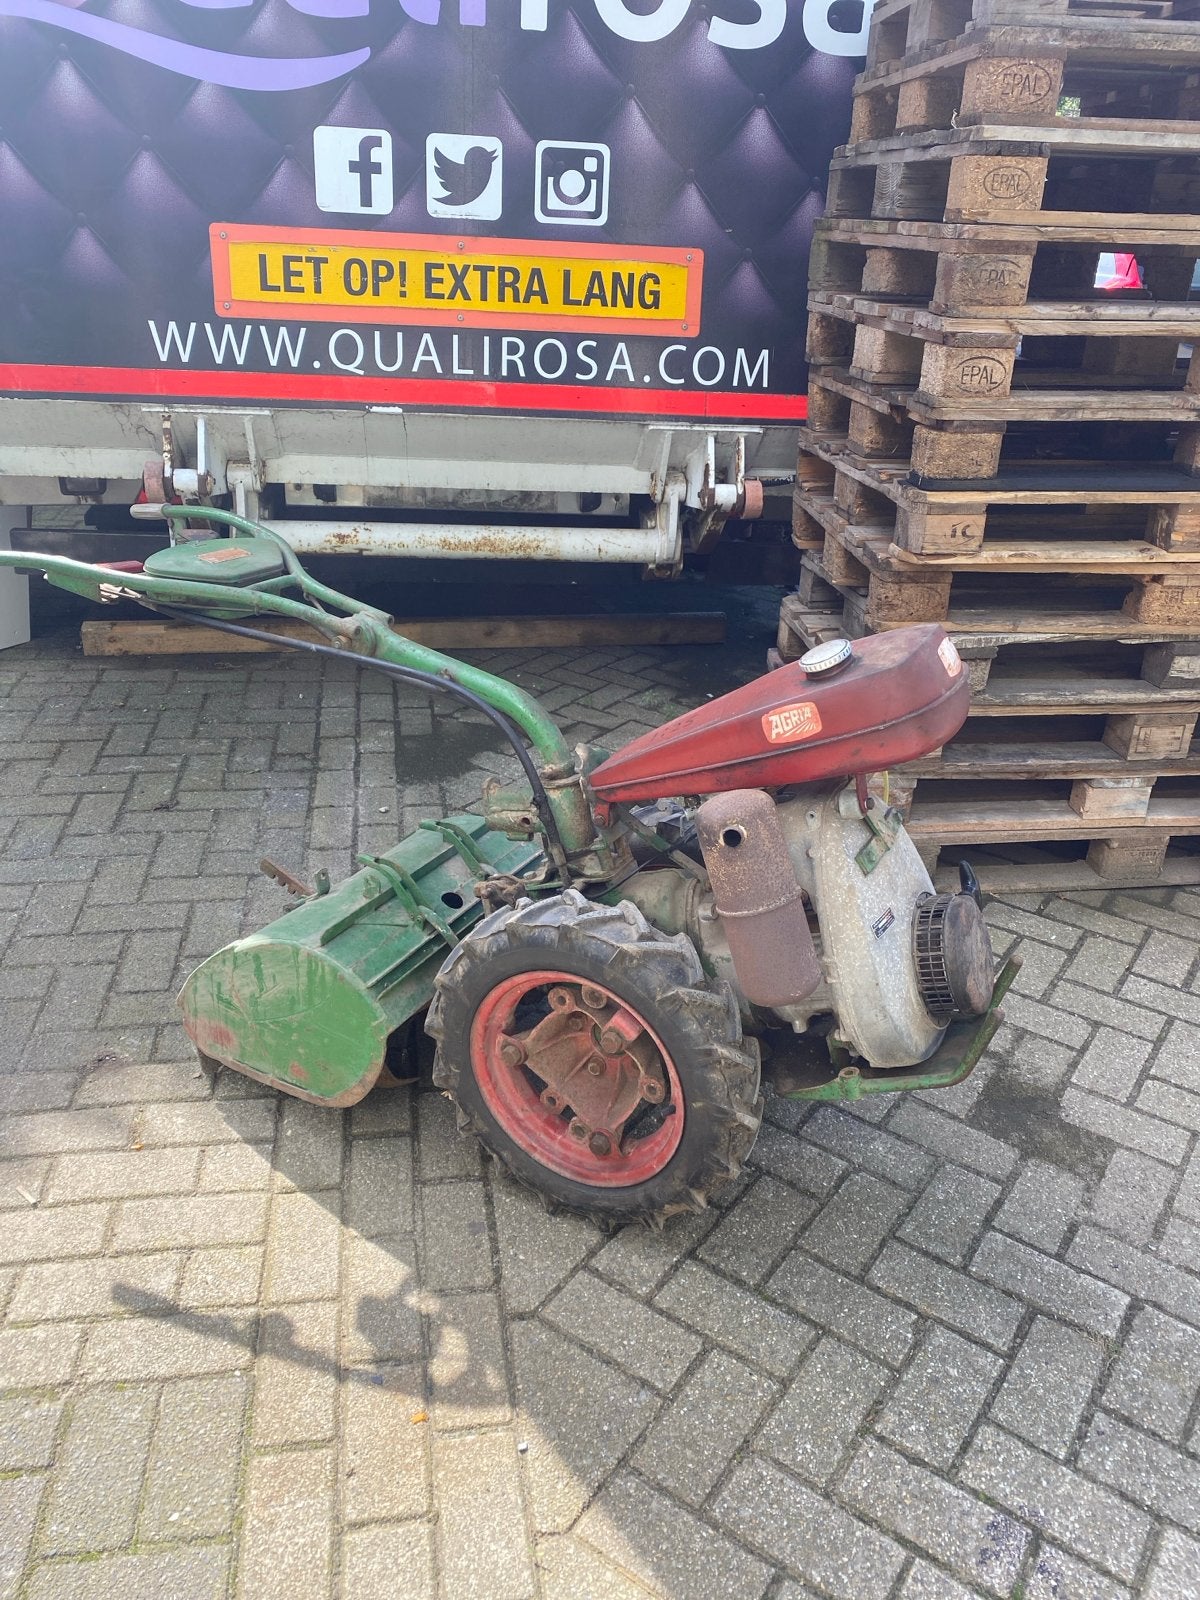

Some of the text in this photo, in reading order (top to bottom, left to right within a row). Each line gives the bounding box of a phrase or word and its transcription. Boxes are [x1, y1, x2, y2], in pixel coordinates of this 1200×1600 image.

[1001, 73, 1041, 96] EPAL
[991, 173, 1024, 192] EPAL
[258, 253, 660, 310] LET OP! EXTRA LANG
[147, 319, 770, 389] WWW.QUALIROSA.COM
[961, 365, 998, 384] EPAL
[767, 706, 812, 740] AGRIA
